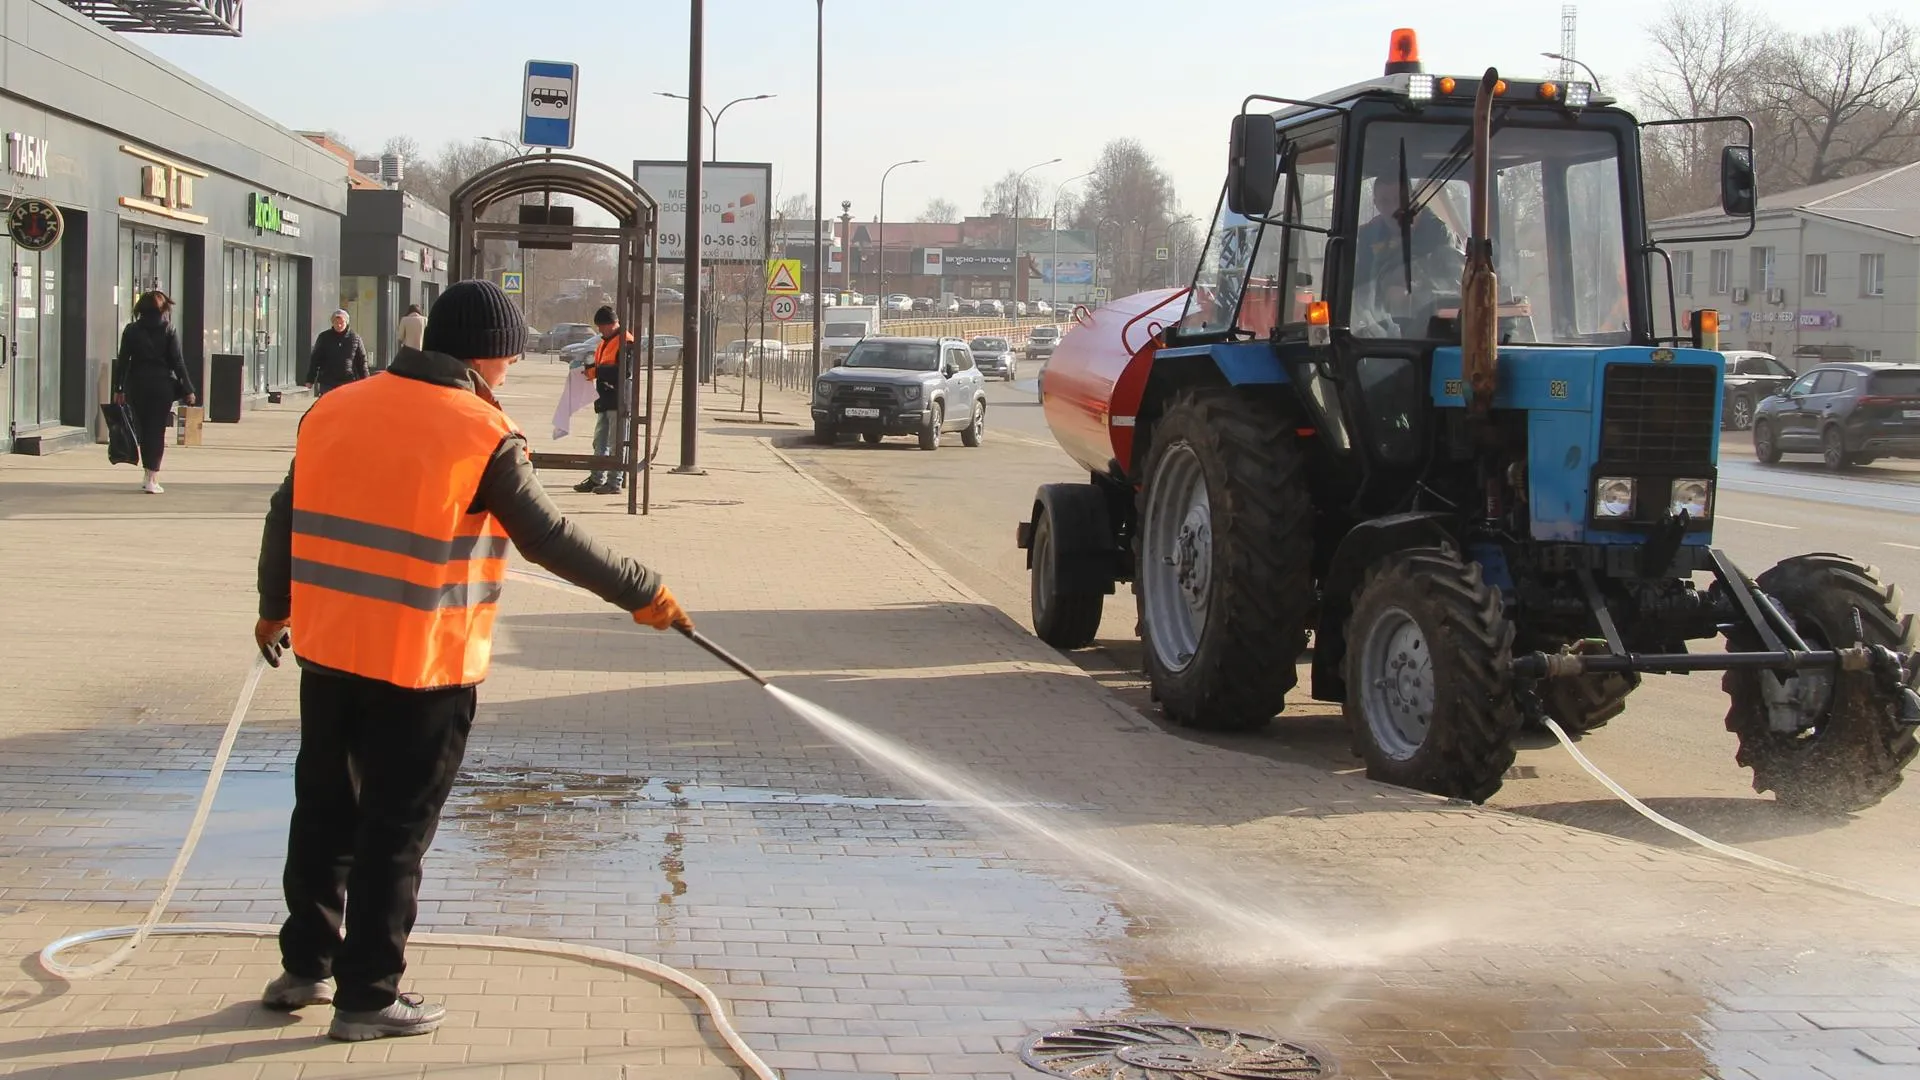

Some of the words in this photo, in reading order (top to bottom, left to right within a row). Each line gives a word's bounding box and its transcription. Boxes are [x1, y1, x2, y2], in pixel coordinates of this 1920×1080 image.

[11, 131, 49, 178] ТАБАК
[668, 189, 708, 199] МЕО
[11, 202, 58, 231] ТАБАК
[646, 233, 681, 248] (99)
[776, 302, 791, 313] 20
[1550, 381, 1567, 397] 821
